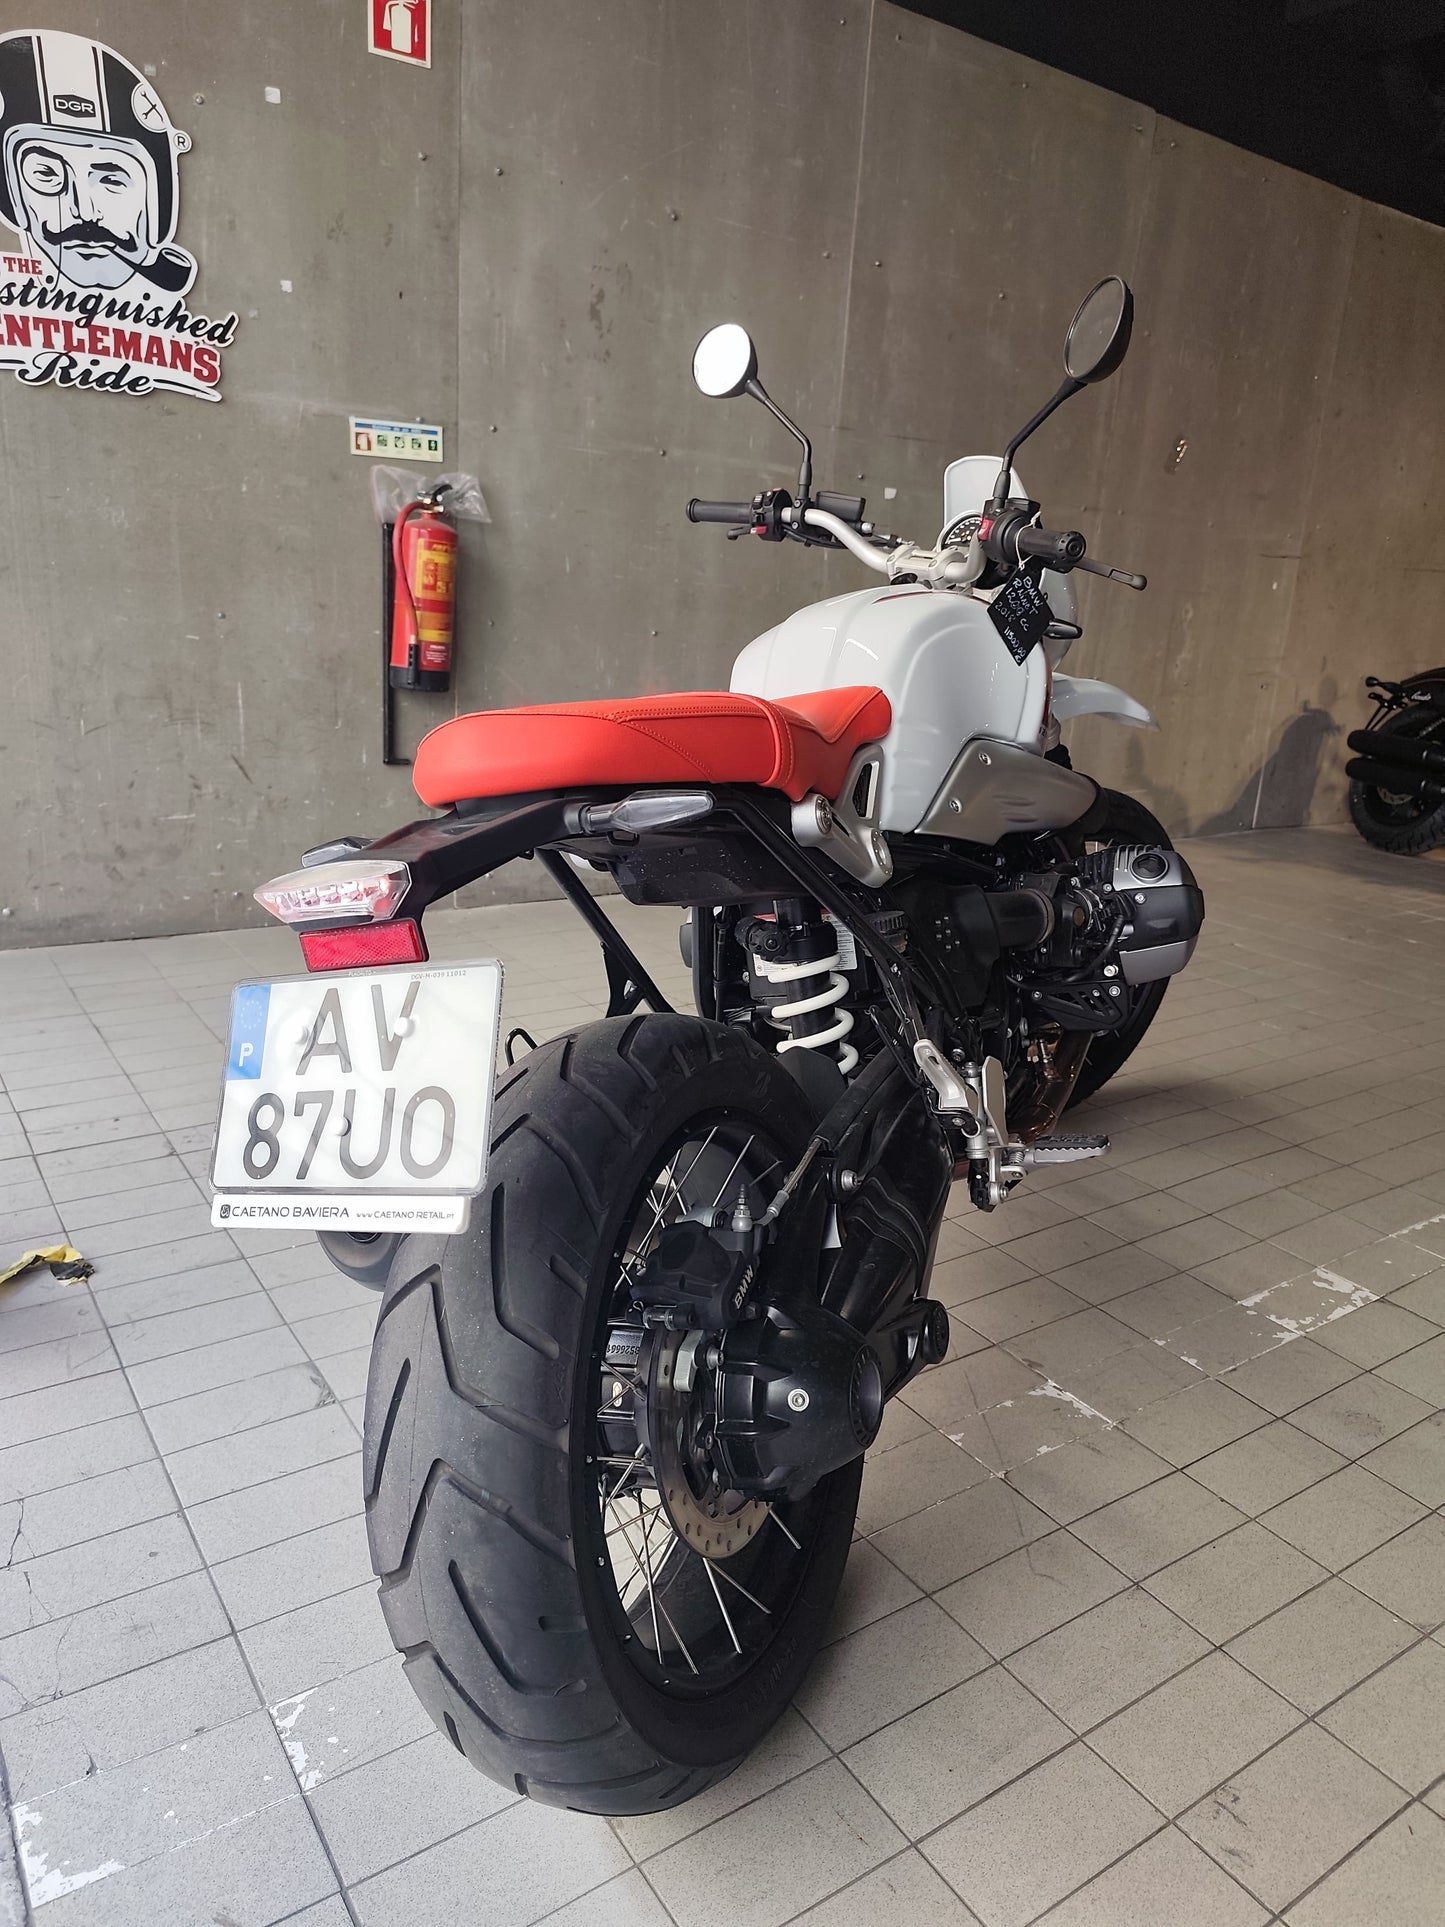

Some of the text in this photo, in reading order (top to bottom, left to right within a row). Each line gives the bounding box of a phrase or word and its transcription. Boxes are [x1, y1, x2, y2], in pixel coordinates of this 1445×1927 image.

[55, 98, 95, 114] DGR
[3, 256, 43, 276] THE
[0, 313, 218, 383] NTLEMAN'S
[18, 351, 152, 393] Ride
[1023, 576, 1044, 607] BMW
[295, 981, 421, 1075] AV
[239, 1042, 254, 1067] P
[232, 1206, 350, 1218] CAETANO BAVIERA
[734, 1264, 754, 1310] BMW
